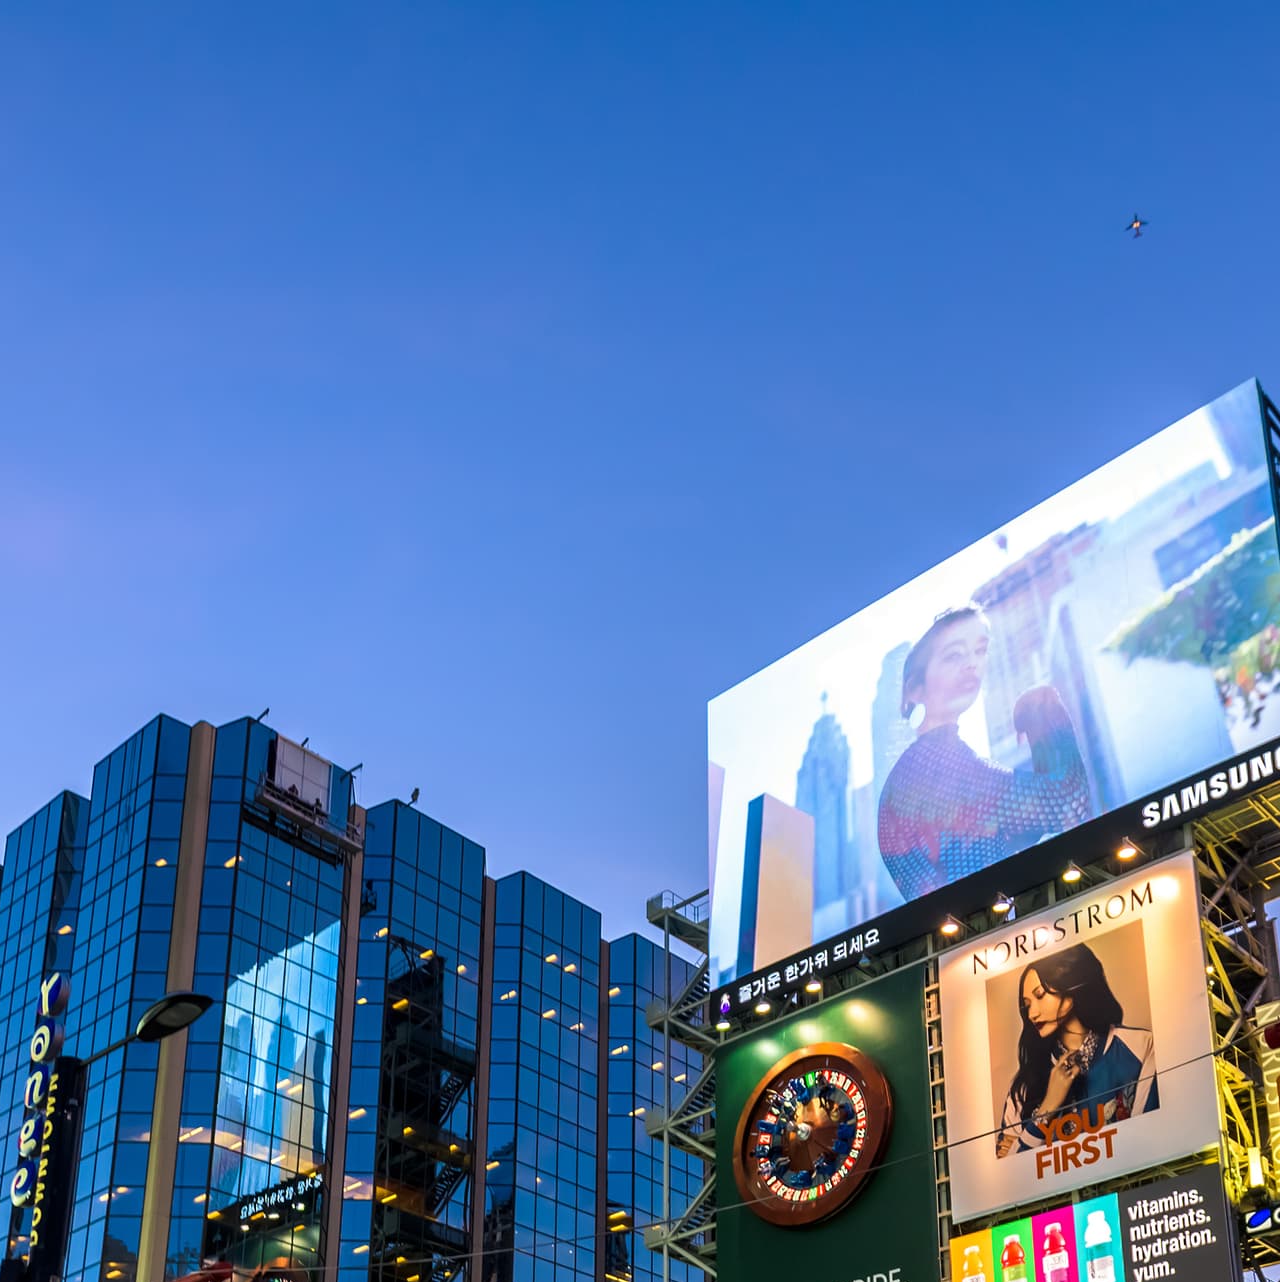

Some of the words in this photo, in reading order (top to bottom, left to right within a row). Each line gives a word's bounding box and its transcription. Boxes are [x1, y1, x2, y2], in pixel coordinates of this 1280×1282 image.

[972, 881, 1155, 975] NORDSTROM
[738, 971, 781, 1004] 즐거운
[785, 949, 829, 983] 한가위
[833, 928, 881, 962] 되세요
[1036, 1103, 1107, 1147] YOU
[30, 1072, 59, 1247] DOWNTOWN
[1034, 1127, 1118, 1180] FIRST
[1127, 1188, 1204, 1221] vitamins.
[1130, 1208, 1211, 1242] nutrients.
[1131, 1228, 1216, 1265] hydration.
